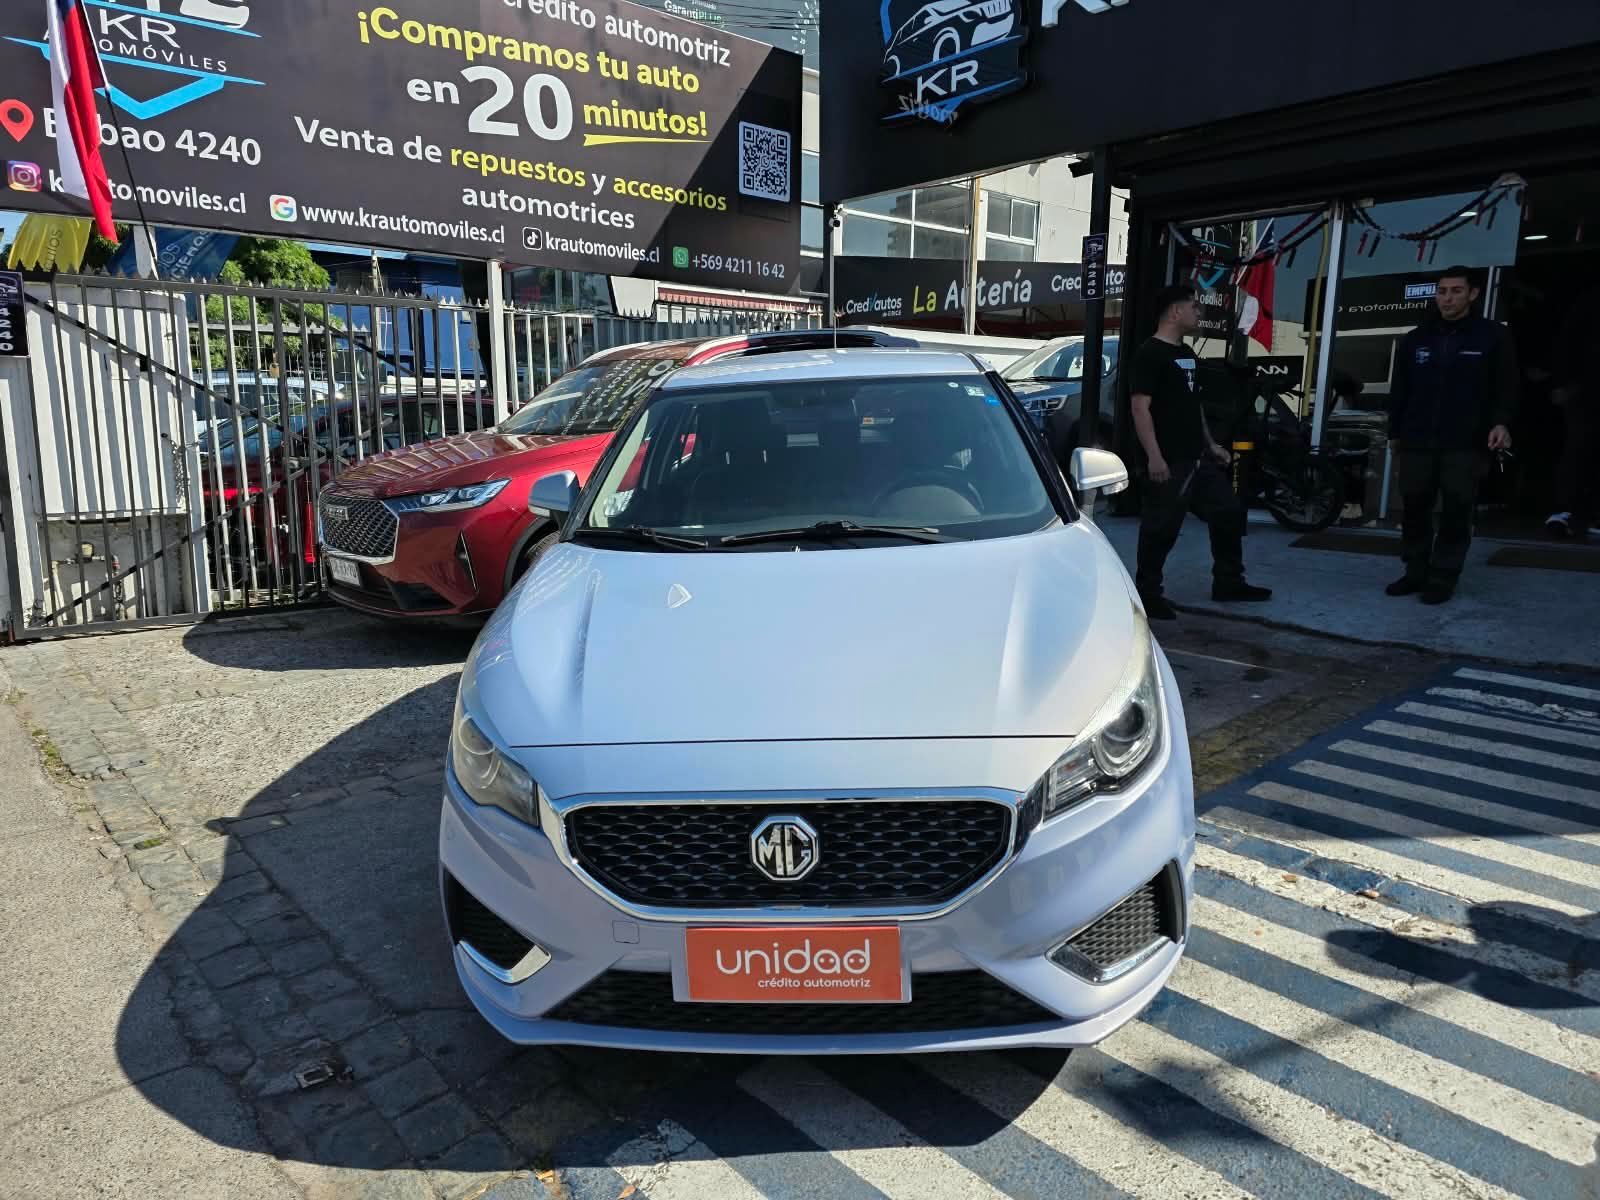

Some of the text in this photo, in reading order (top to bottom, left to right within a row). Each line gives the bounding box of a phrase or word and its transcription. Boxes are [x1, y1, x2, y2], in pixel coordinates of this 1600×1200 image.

[100, 8, 181, 48] KR
[605, 11, 731, 68] automotriz
[358, 7, 700, 94] ¡Compramos tu auto
[916, 59, 980, 102] KR
[407, 65, 708, 142] en 20 minutos!
[44, 107, 262, 166] Bbao 4240
[294, 115, 728, 212] Venta de repuestos y accesorios
[302, 207, 505, 244] www.krautomoviles.cl
[462, 187, 635, 229] automotrices
[545, 231, 660, 264] krautomoviles.cl
[692, 253, 785, 278] +569 4211 16 42
[913, 269, 1032, 315] La Atería
[758, 825, 811, 876] MG
[716, 938, 871, 975] unidad
[757, 977, 871, 988] crédito automotriz
